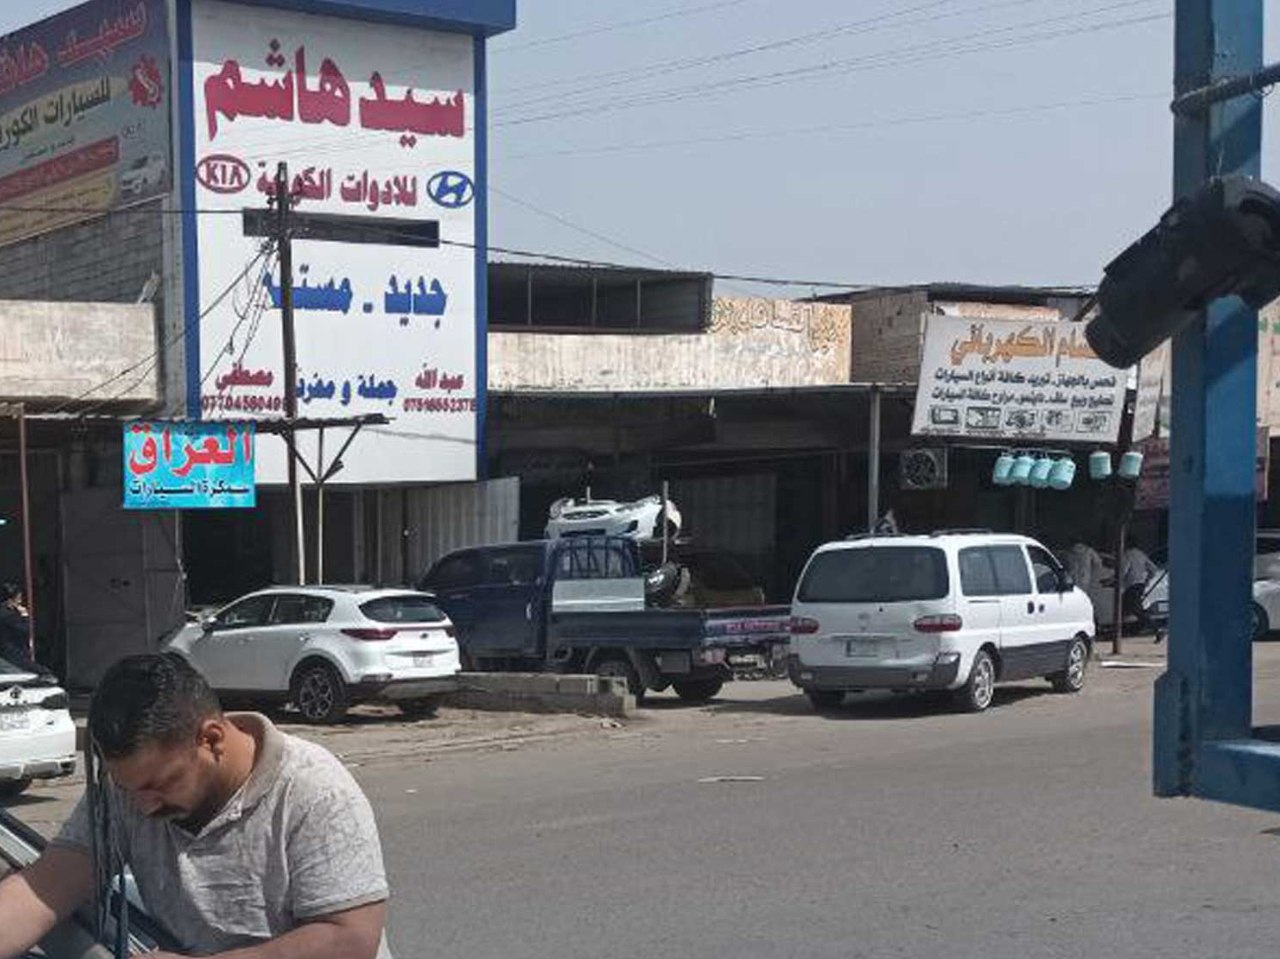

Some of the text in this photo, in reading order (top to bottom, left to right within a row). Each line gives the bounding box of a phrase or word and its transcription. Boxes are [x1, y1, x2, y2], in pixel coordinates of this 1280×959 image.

[42, 76, 111, 128] للسيارات
[204, 39, 465, 148] سيد هاشم
[204, 160, 244, 187] KIA
[256, 161, 417, 211] للادوات الكوية
[384, 274, 448, 329] جديد
[951, 322, 1055, 366] الكهربائي
[341, 379, 352, 406] و
[357, 373, 398, 405] جملة
[439, 370, 465, 394] عبد
[130, 423, 251, 476] العراق
